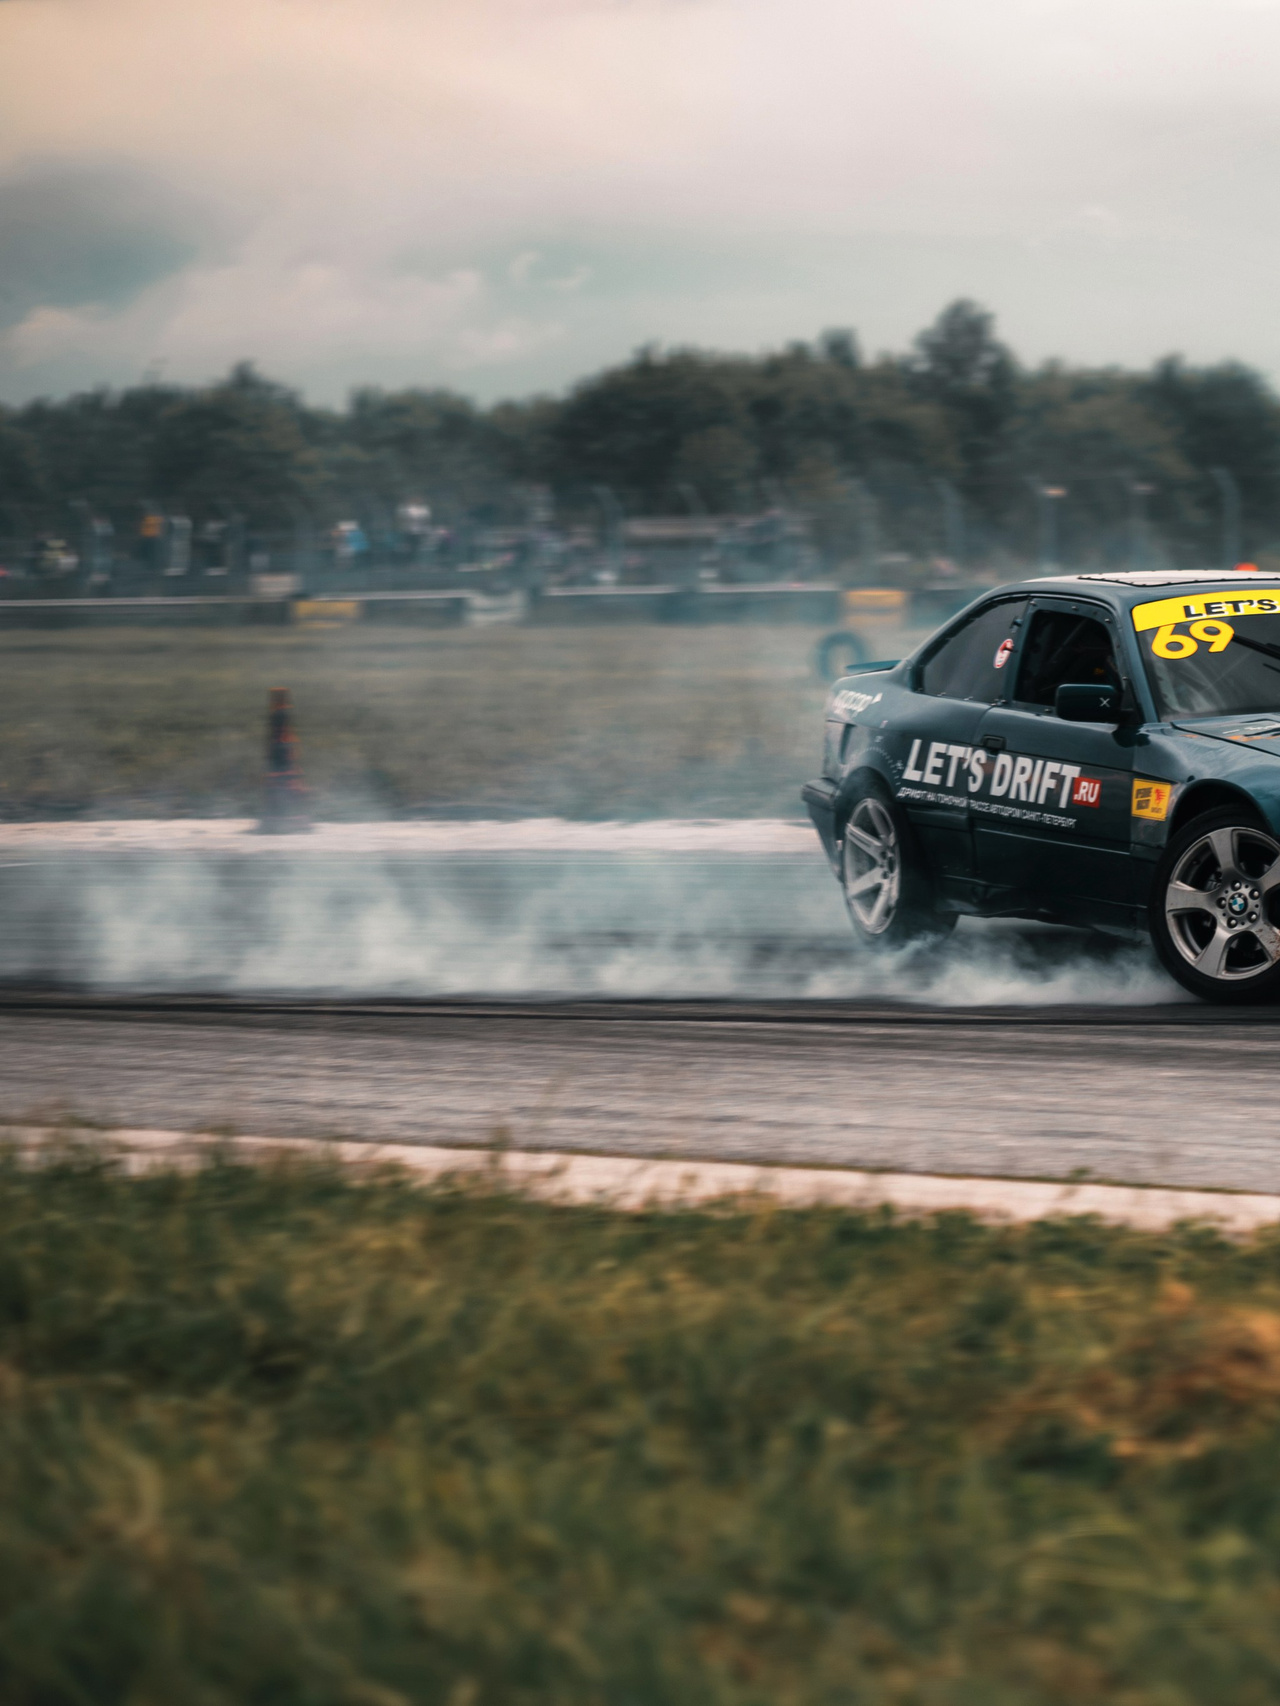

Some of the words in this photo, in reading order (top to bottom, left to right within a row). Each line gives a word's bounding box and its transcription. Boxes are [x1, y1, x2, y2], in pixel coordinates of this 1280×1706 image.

[1183, 598, 1280, 619] LET'S
[1151, 619, 1235, 660] 69
[902, 738, 987, 793] LET'S
[990, 753, 1081, 809] DRIFT
